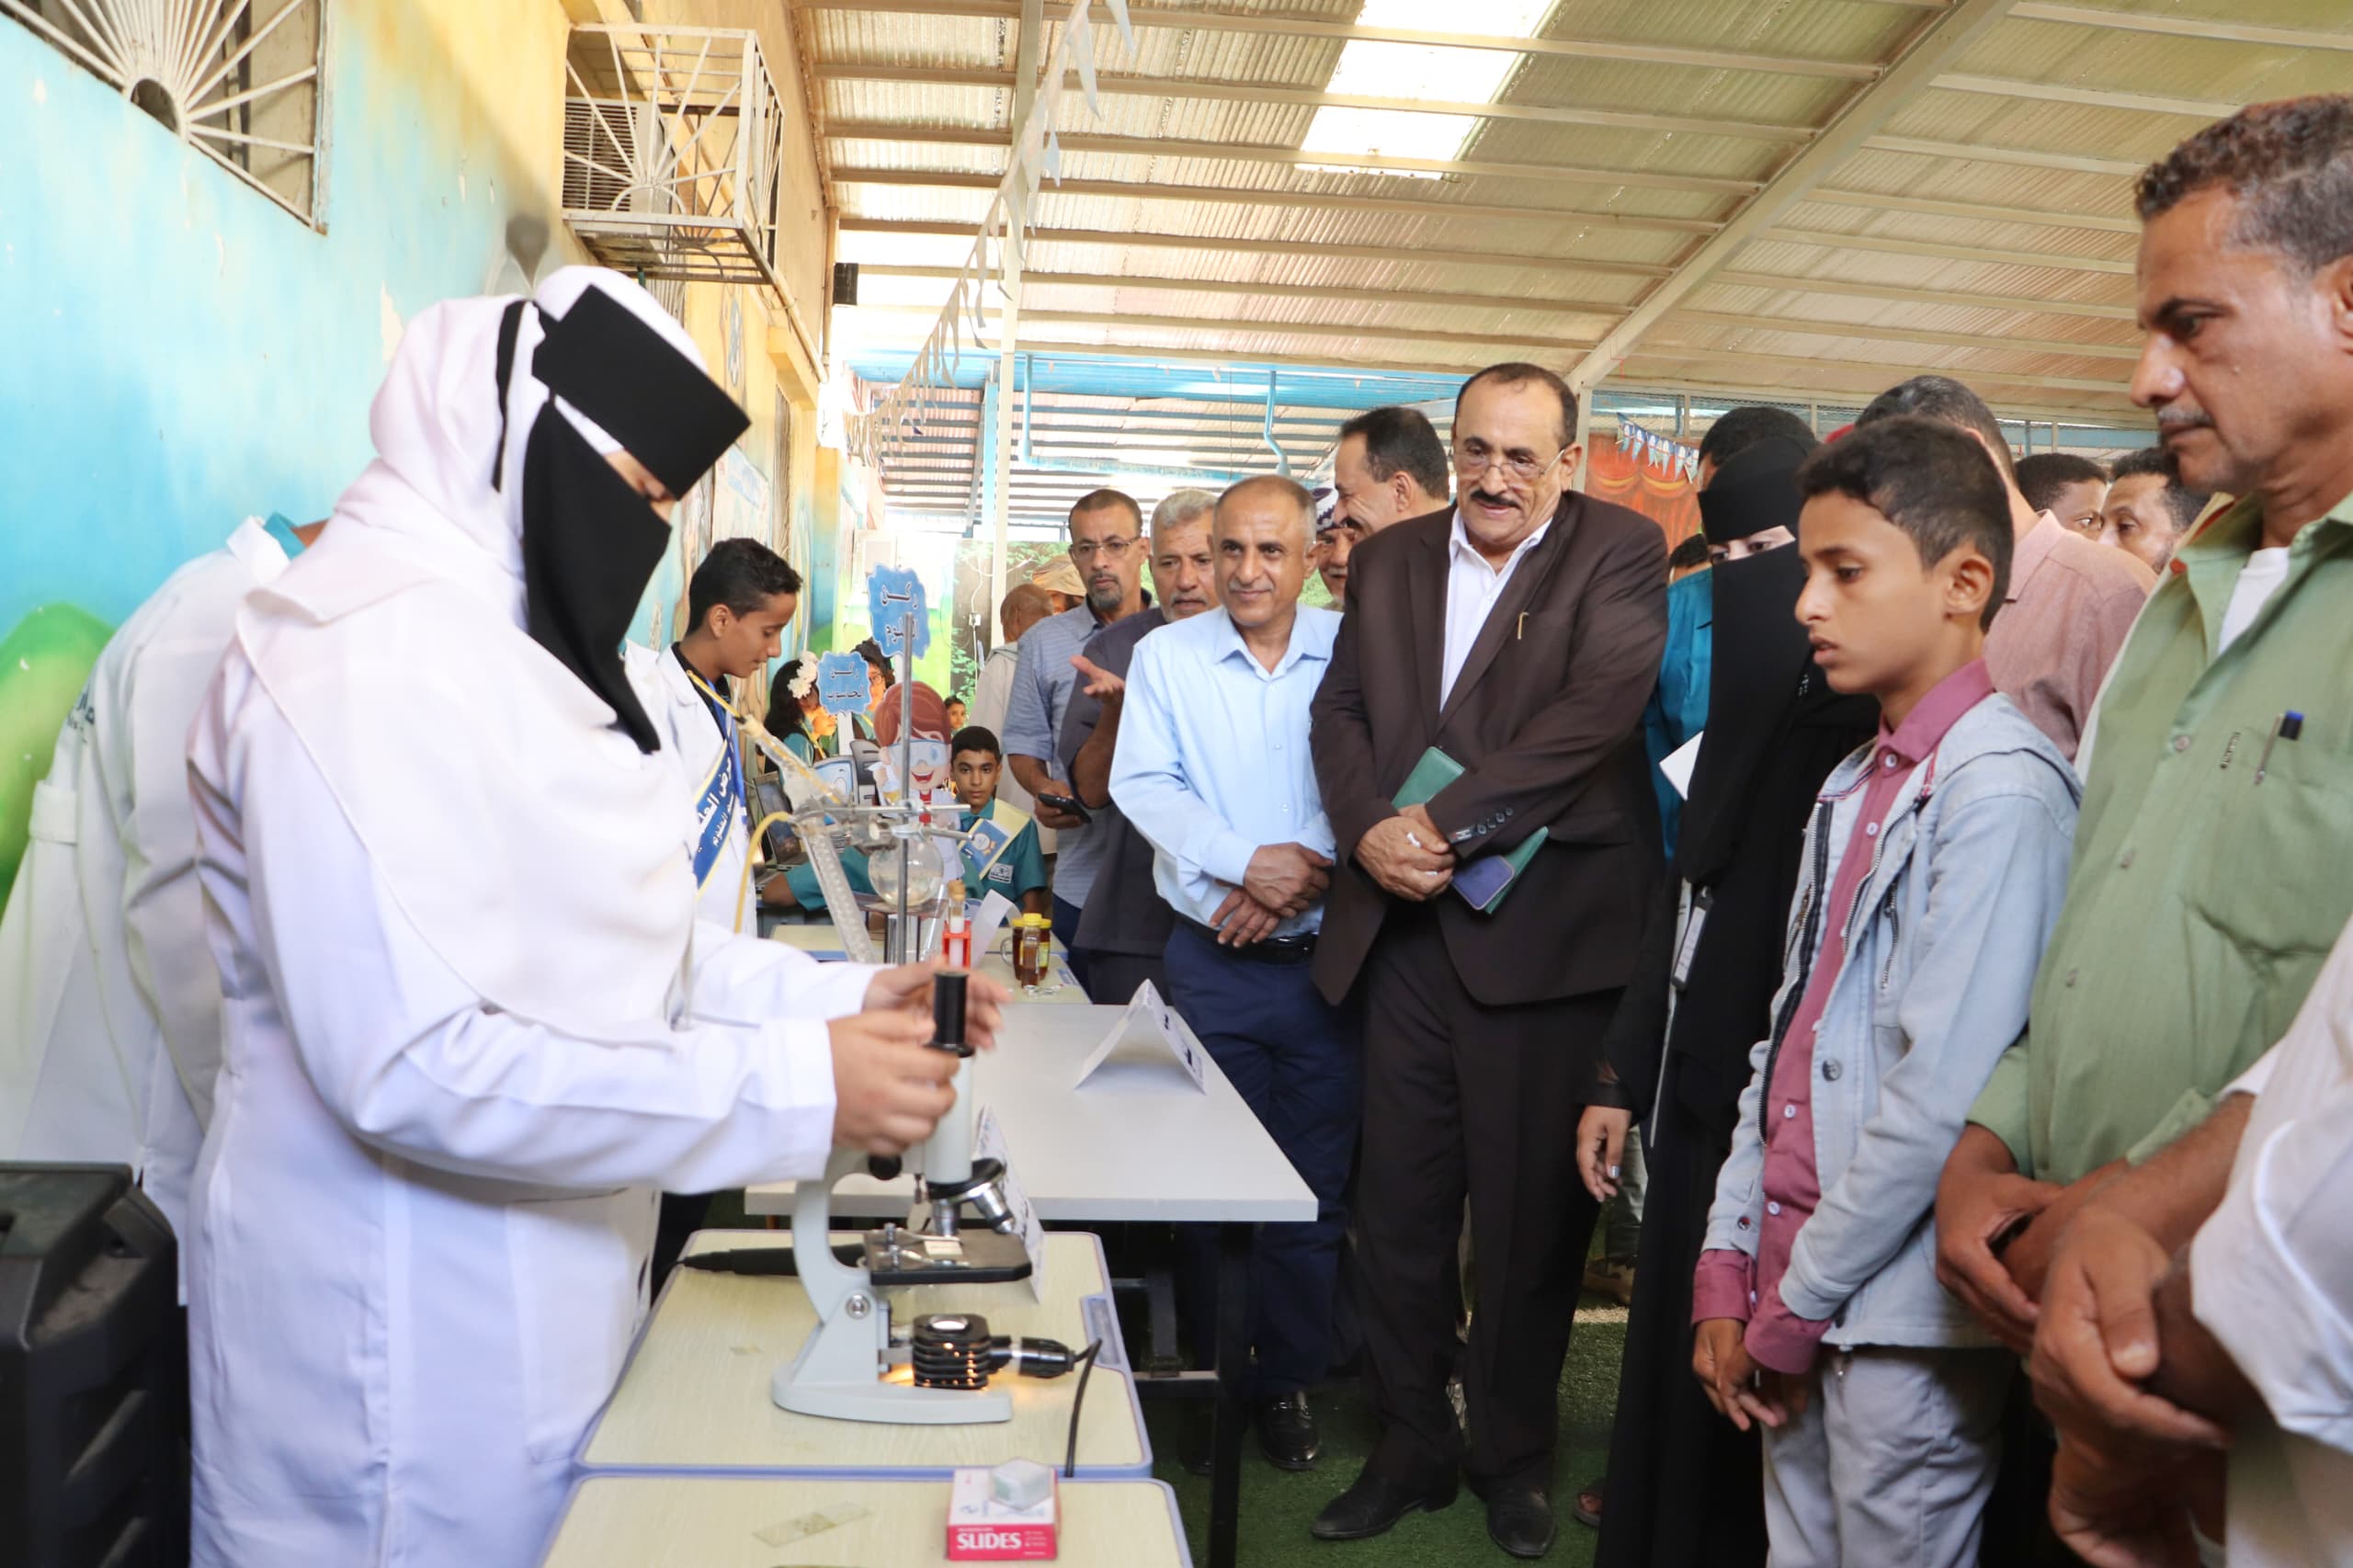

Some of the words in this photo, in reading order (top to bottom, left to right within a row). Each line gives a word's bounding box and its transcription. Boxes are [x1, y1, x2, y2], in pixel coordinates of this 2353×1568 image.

[881, 581, 918, 610] ركن
[886, 617, 919, 647] اللوم
[831, 662, 860, 679] ركن
[957, 1531, 1022, 1550] SLIDES
